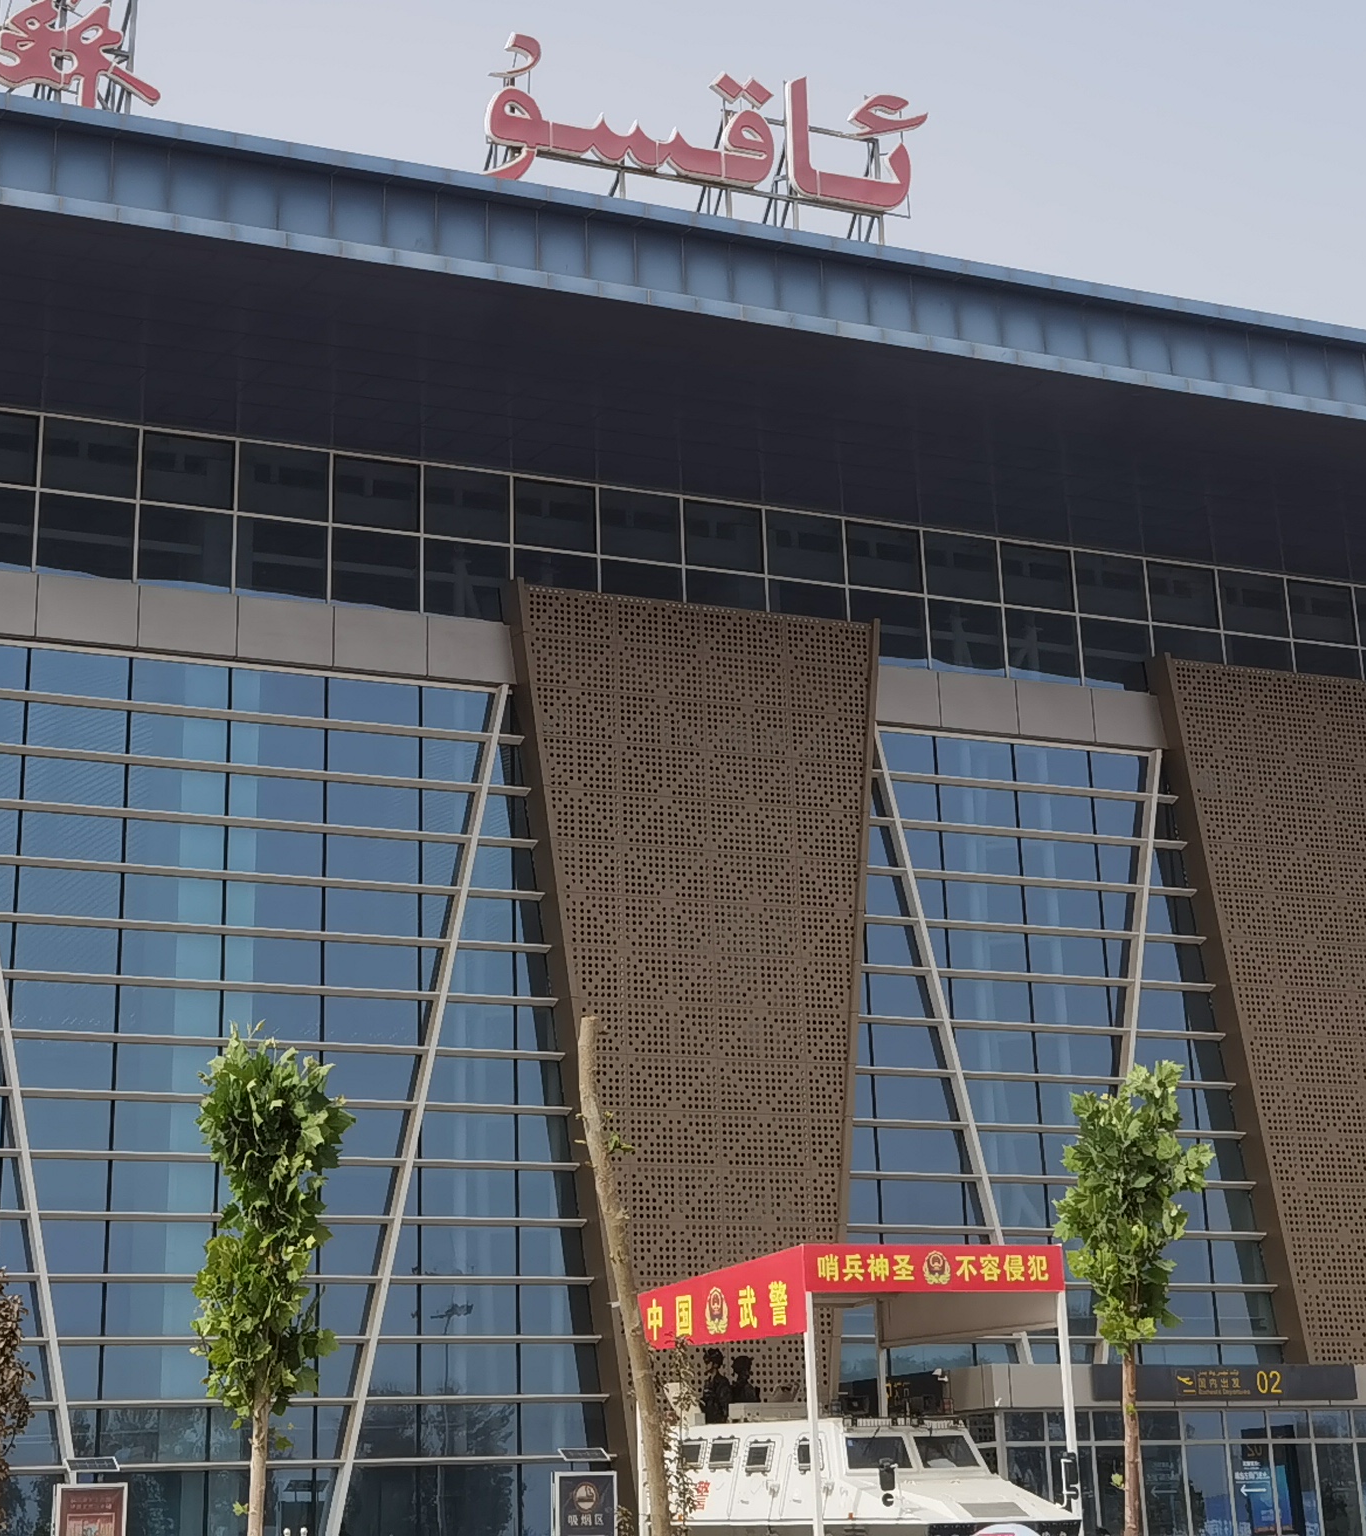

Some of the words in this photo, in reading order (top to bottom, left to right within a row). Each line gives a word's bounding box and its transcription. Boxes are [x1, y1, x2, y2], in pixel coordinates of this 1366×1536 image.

[817, 1253, 915, 1282] 哨兵神圣
[955, 1254, 1049, 1282] 不容侵犯
[647, 1294, 693, 1341] 中国
[738, 1280, 788, 1329] 武警
[1257, 1370, 1283, 1394] 02
[567, 1513, 605, 1526] 吸烟区
